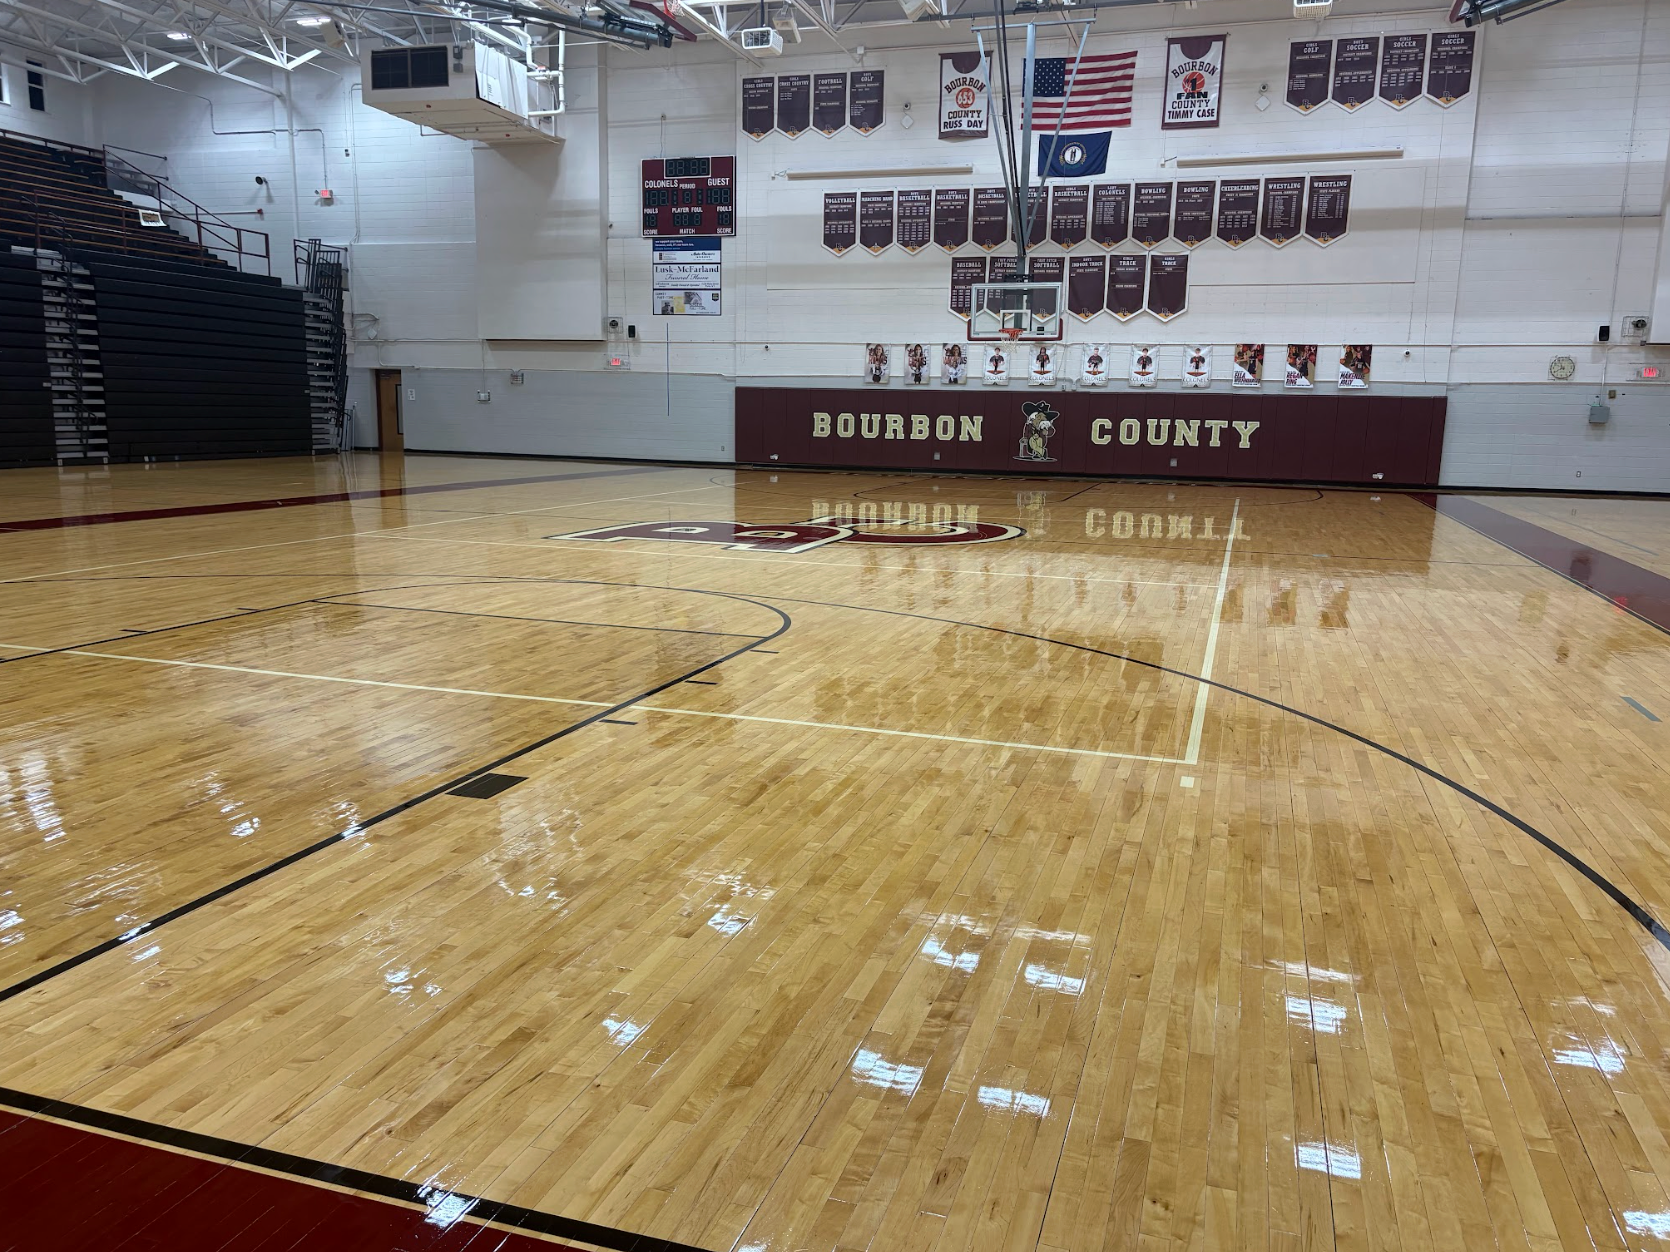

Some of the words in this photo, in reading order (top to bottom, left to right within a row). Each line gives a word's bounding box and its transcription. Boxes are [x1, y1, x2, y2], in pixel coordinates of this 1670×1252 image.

[1171, 61, 1218, 78] BOURBON
[944, 77, 986, 94] BOURBON
[957, 91, 973, 104] 653
[1176, 91, 1208, 100] FAN
[1171, 99, 1211, 109] COUNTY
[948, 110, 982, 119] COUNTY
[1168, 110, 1194, 119] TIMMY
[1196, 108, 1215, 118] CASE
[943, 120, 962, 129] RUSS
[967, 120, 983, 128] DAY
[644, 179, 678, 188] COLONELS
[707, 178, 730, 186] GUEST
[1268, 182, 1301, 190] WRESTLING
[655, 265, 719, 273] Lusk-McFarland
[813, 412, 983, 441] BOURBON
[1091, 418, 1260, 448] COUNTY
